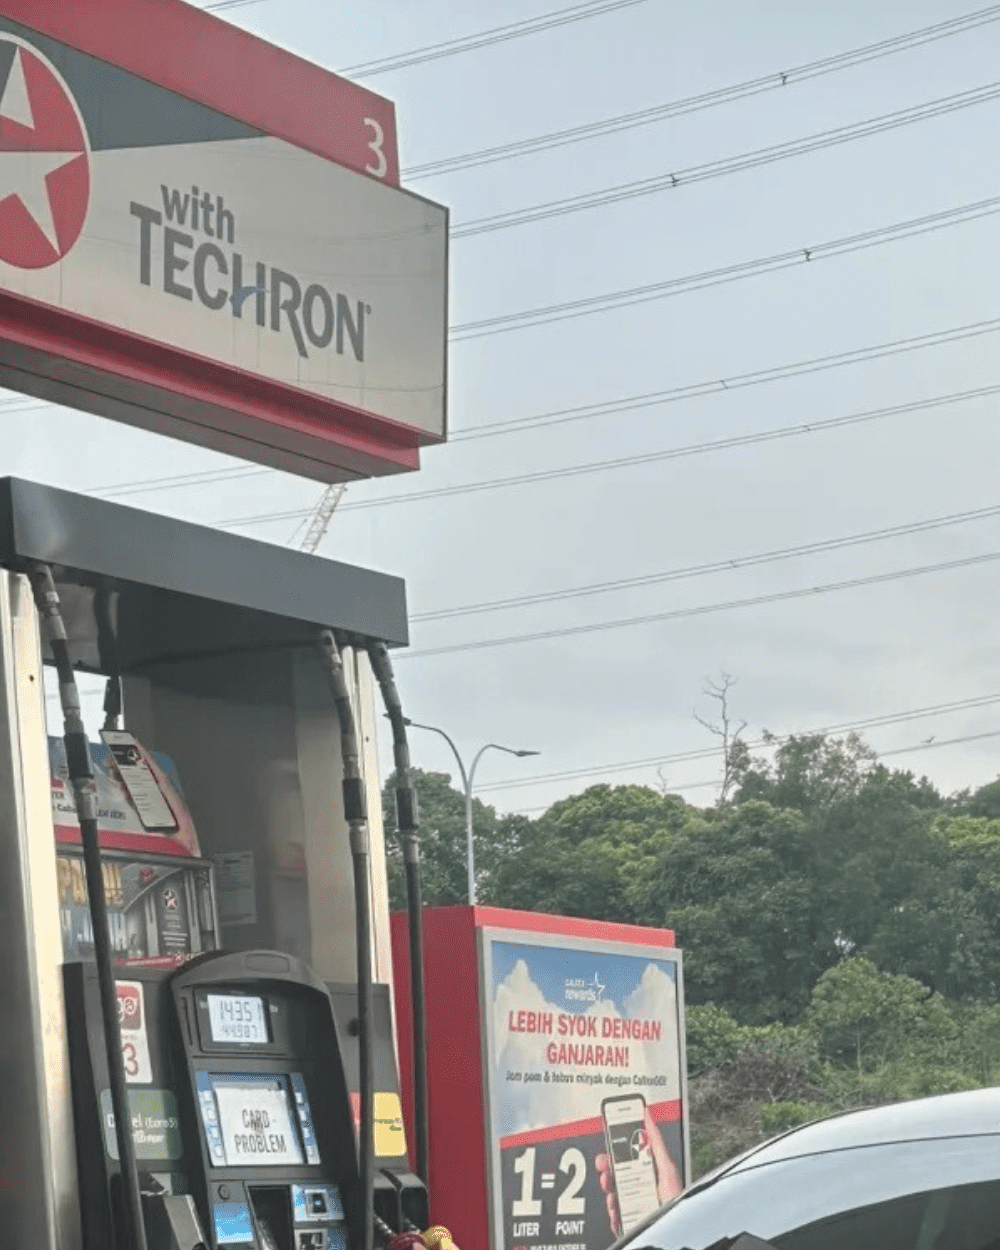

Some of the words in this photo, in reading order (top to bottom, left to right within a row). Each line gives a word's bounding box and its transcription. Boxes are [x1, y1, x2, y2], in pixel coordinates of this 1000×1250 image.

[363, 117, 388, 177] 3
[160, 184, 235, 244] with
[129, 200, 366, 362] TECHRON
[507, 1009, 553, 1034] LEBIH
[557, 1013, 597, 1037] SYOK
[601, 1017, 662, 1041] DENGAN
[546, 1042, 630, 1067] GANJARAN!
[604, 1073, 631, 1087] dengan
[242, 1108, 270, 1128] CARD
[234, 1133, 287, 1153] PROBLEM
[513, 1222, 539, 1237] LITER
[555, 1220, 585, 1236] POINT
